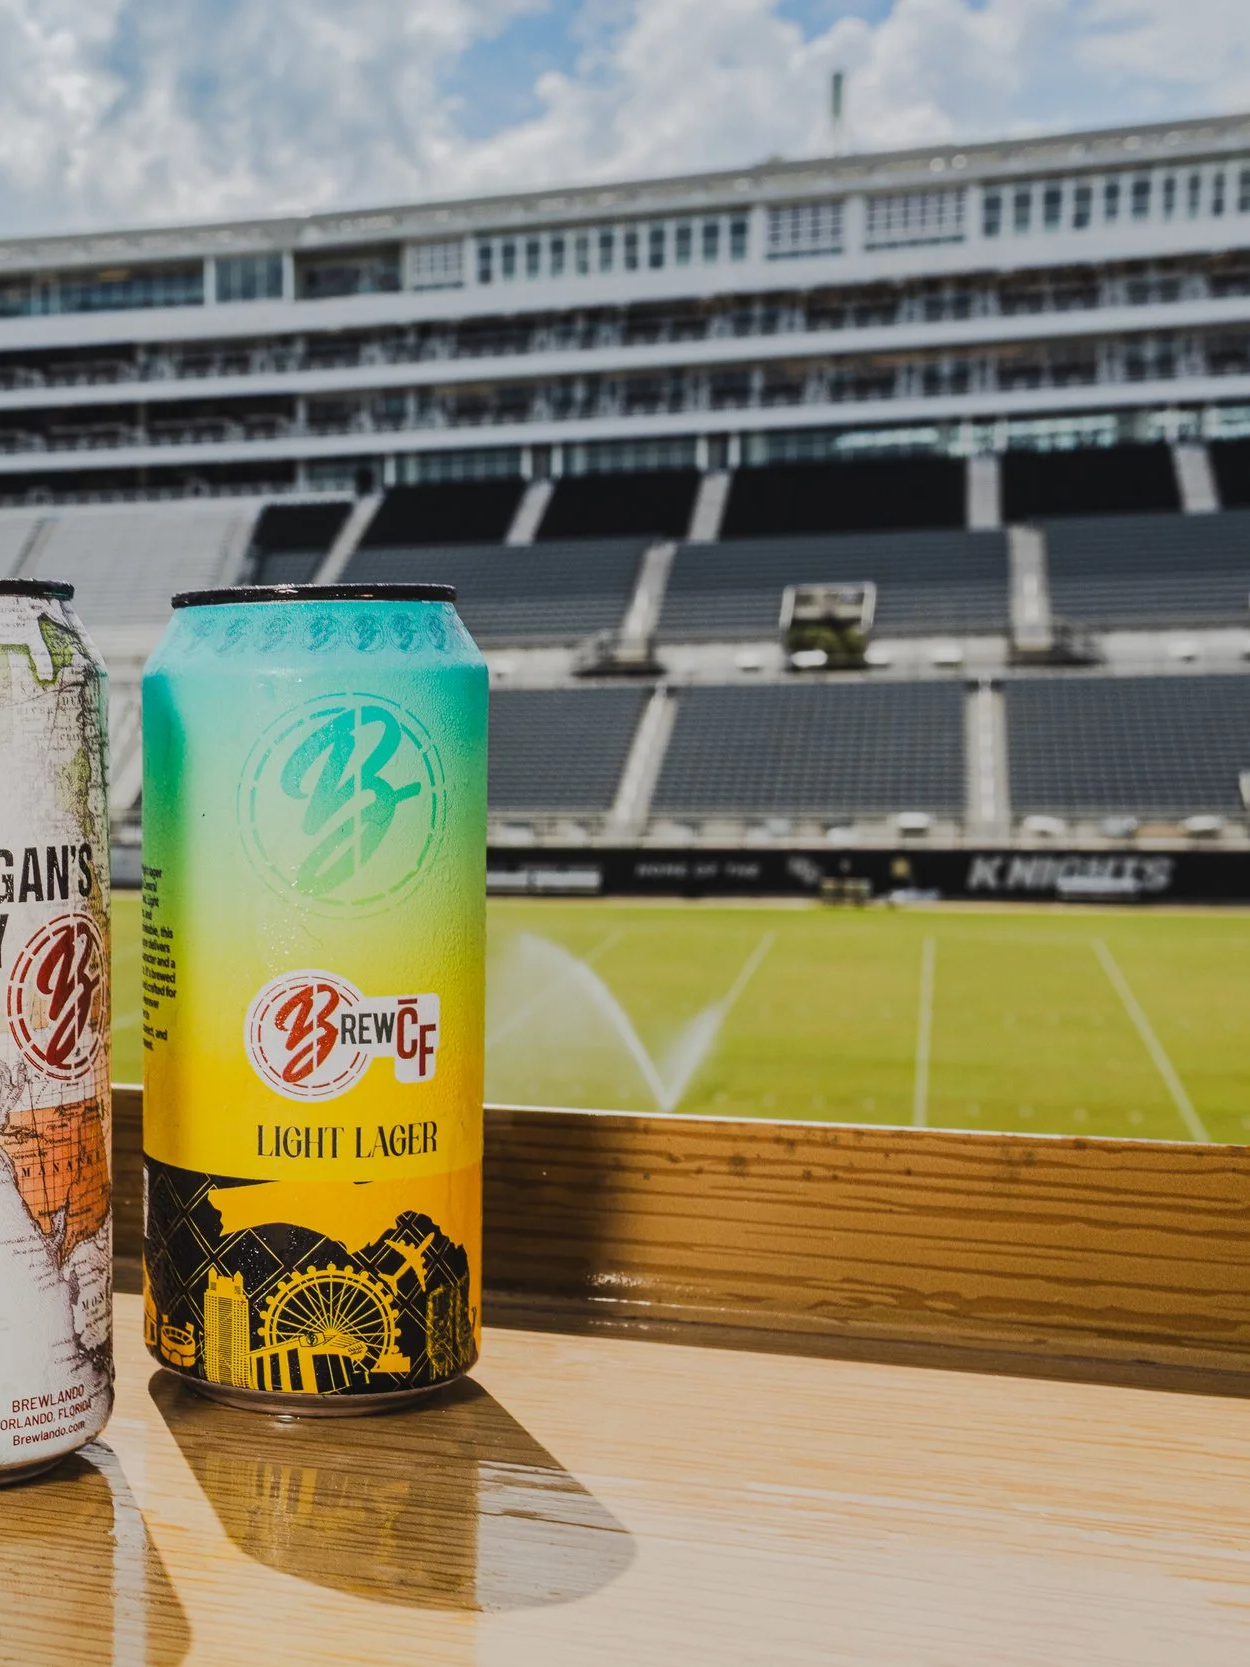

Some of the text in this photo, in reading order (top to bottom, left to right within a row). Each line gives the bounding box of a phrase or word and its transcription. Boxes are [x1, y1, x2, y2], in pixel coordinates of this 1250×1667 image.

[257, 1121, 437, 1159] LIGHT LAGER
[12, 1384, 85, 1413] BREWLANDO
[0, 1398, 92, 1431] ORLANDO, FLORIDA
[13, 1419, 86, 1446] Brewlando.com
